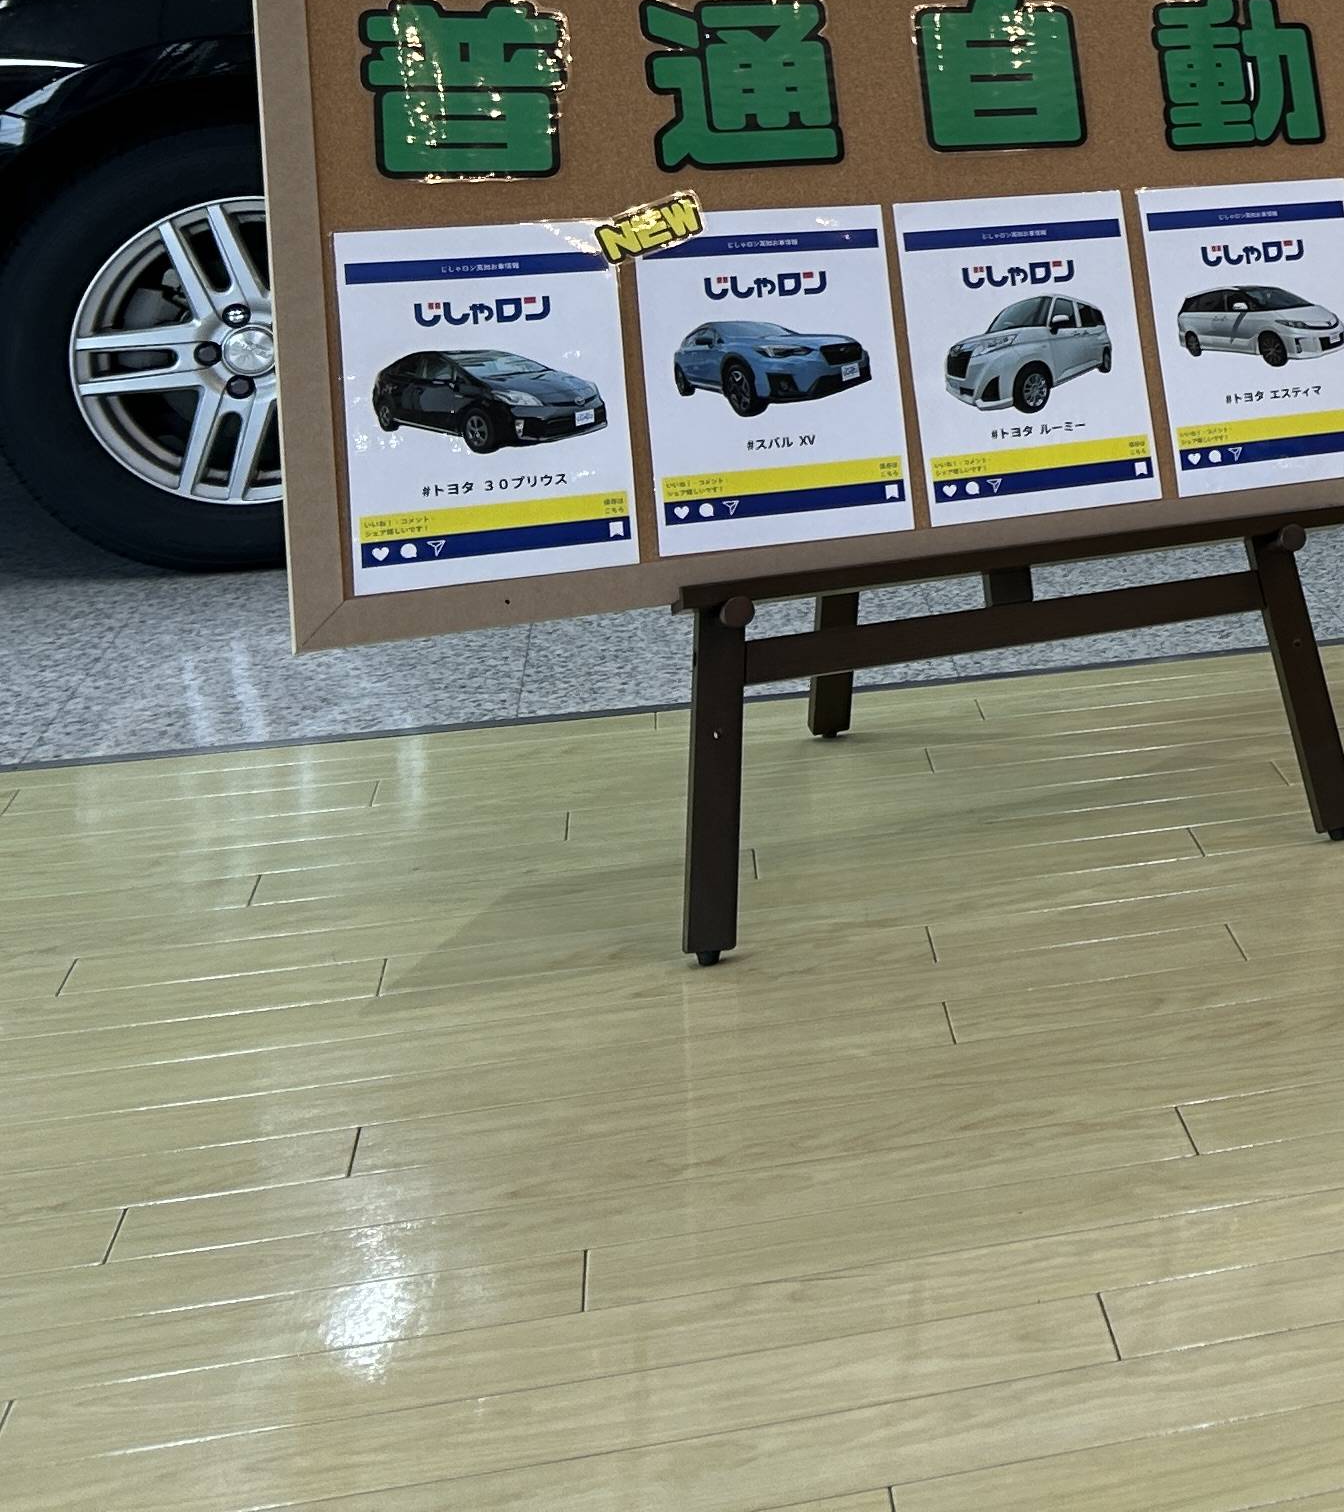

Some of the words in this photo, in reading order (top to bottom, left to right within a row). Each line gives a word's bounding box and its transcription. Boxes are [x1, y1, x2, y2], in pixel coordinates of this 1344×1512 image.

[598, 195, 701, 263] NEW
[1200, 239, 1305, 267] じしゃロン
[704, 271, 827, 301] じしゃロン
[961, 259, 1075, 289] じしゃロン
[414, 296, 550, 327] じしゃロン
[1226, 390, 1264, 404] #トヨタ
[1270, 385, 1322, 399] エスティマ
[747, 437, 793, 451] #スバル
[799, 435, 816, 447] XV
[991, 425, 1033, 439] #トヨタ
[1040, 422, 1086, 435] ルーミー
[422, 481, 474, 498] #トヨタ
